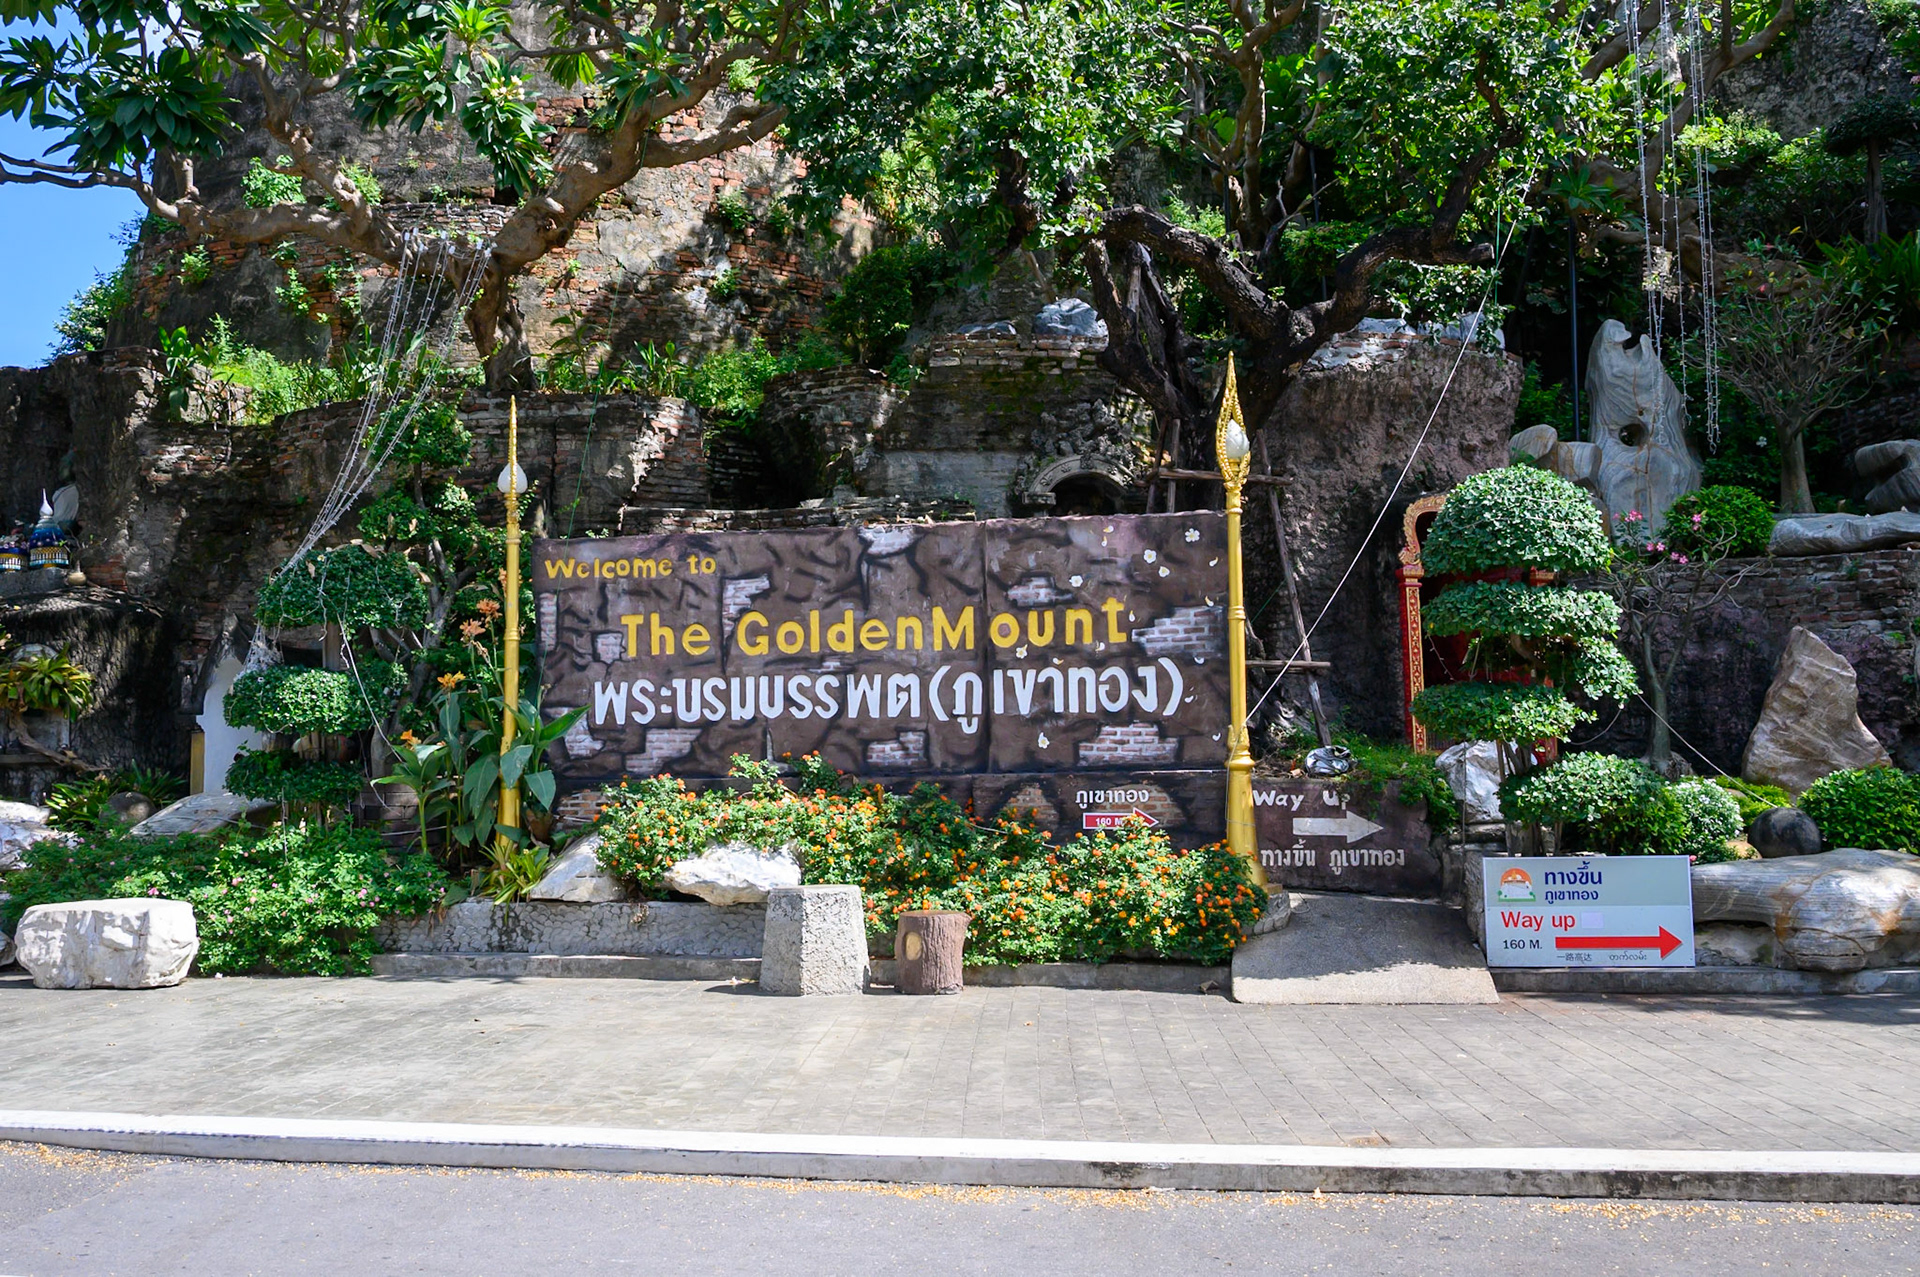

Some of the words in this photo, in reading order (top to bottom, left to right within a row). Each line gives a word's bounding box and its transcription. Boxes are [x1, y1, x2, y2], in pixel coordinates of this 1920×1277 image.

[544, 557, 674, 580] Welcome
[686, 553, 717, 575] to
[620, 612, 711, 658] The
[1075, 789, 1150, 810] ภูเขาทอง
[1252, 789, 1305, 812] Way
[1095, 817, 1112, 827] 160
[1328, 848, 1405, 876] ภูเขาทอง
[1544, 860, 1603, 885] ทางขึ้น
[1544, 890, 1599, 905] ภูเขาทอง
[1500, 911, 1544, 932] Way
[1551, 914, 1576, 932] up
[1502, 939, 1526, 950] 160
